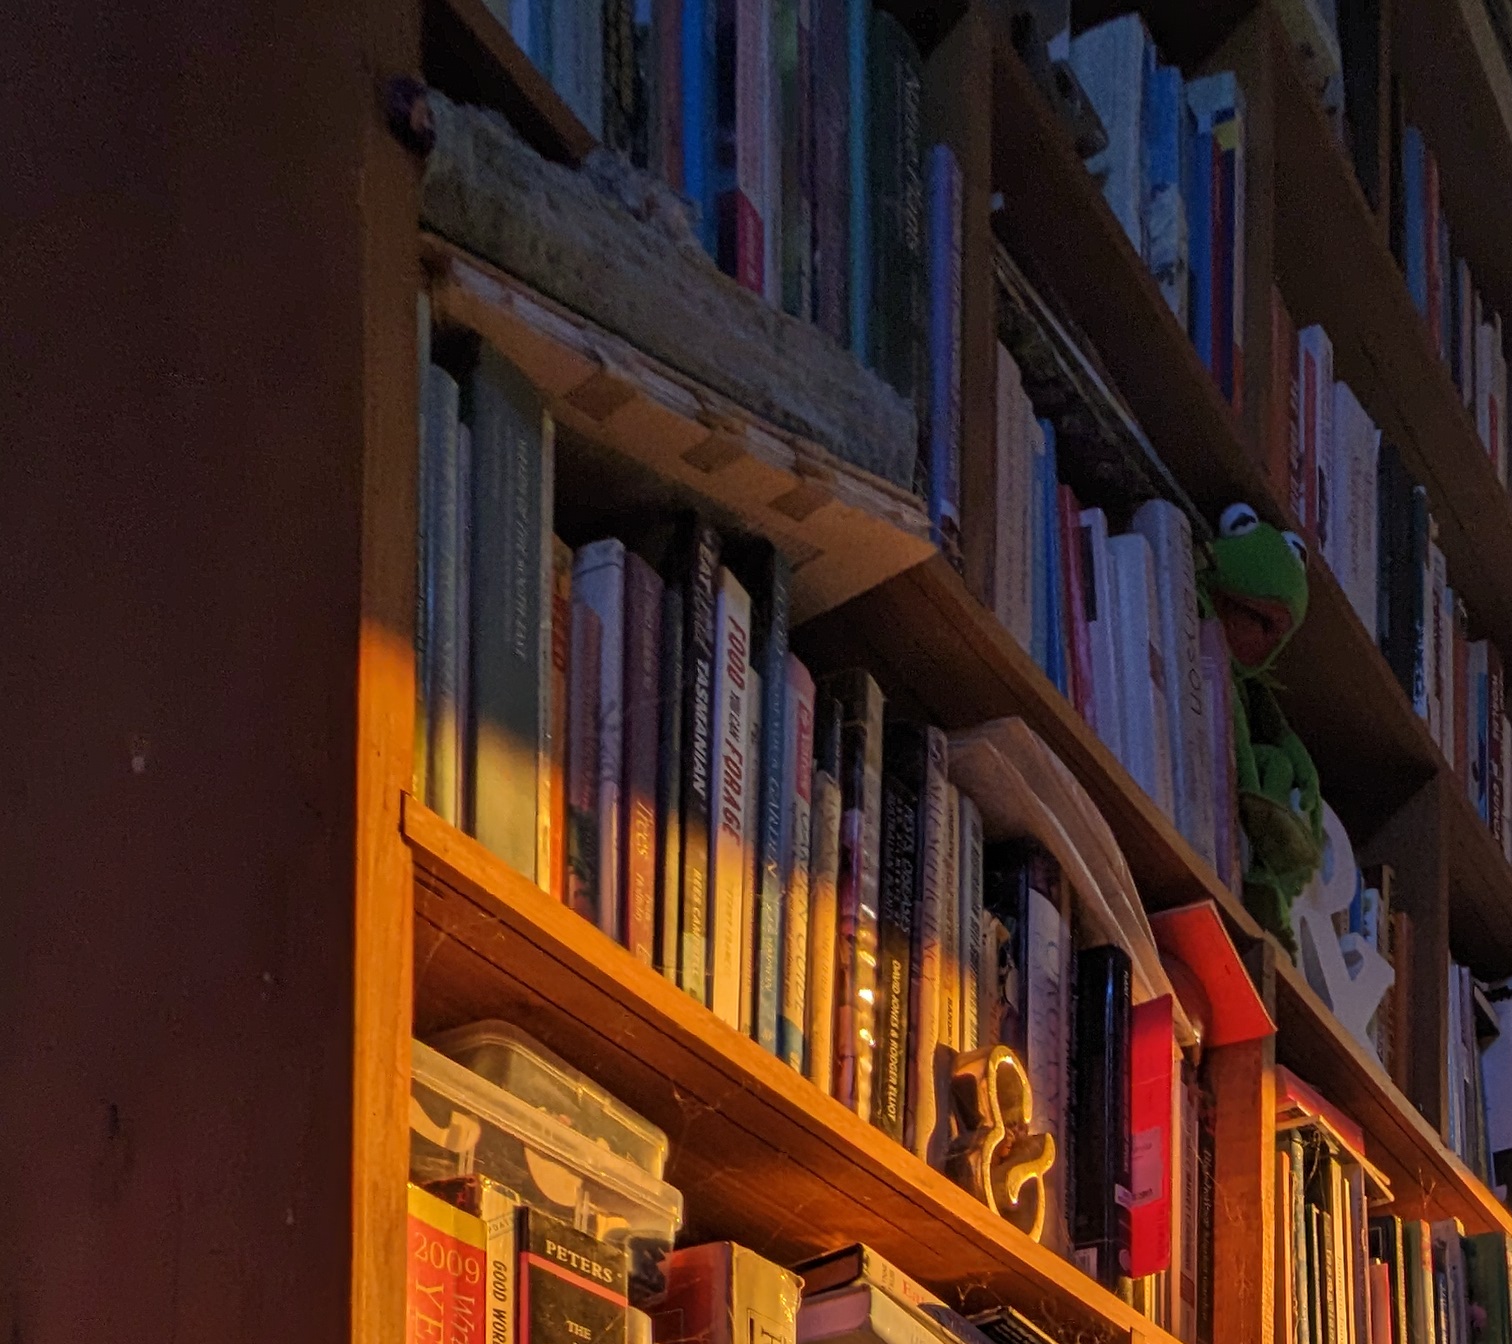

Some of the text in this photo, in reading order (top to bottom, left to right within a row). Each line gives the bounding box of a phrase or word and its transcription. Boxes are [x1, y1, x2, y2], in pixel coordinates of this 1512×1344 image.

[727, 620, 746, 690] FOOD
[693, 659, 711, 797] TASMANIAN
[414, 1231, 481, 1285] 2009
[491, 1259, 509, 1303] GOOD
[545, 1239, 614, 1284] PETERS
[566, 1320, 592, 1342] THE
